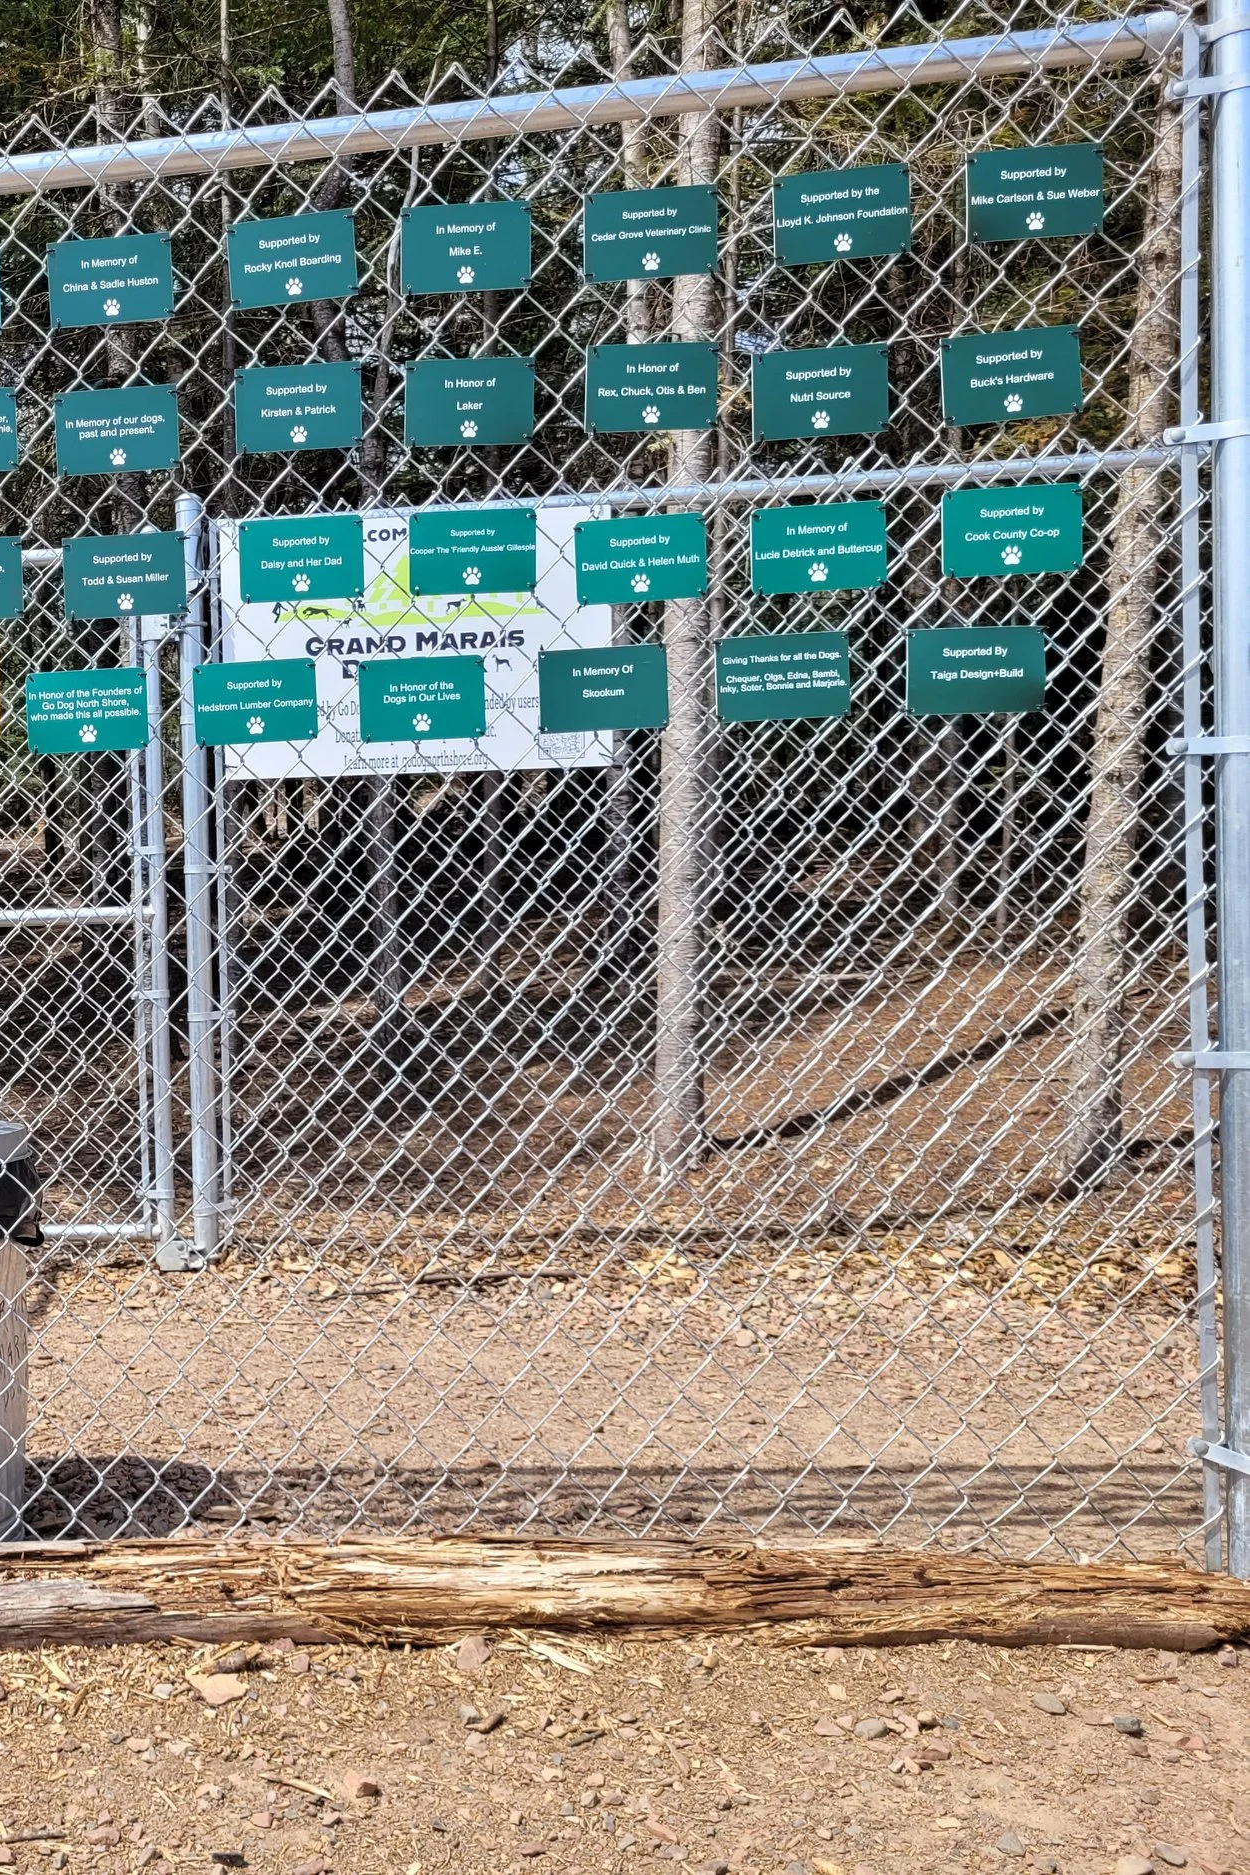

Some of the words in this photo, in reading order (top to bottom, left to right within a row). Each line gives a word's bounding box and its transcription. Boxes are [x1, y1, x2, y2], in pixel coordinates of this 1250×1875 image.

[970, 195, 994, 205] Mike
[996, 193, 1034, 203] Carlson
[1036, 190, 1044, 200] &
[1046, 190, 1065, 200] Sue
[1067, 188, 1101, 199] Weber
[776, 216, 802, 229] Lloyd
[803, 215, 813, 225] K.
[815, 212, 855, 223] Johnson
[856, 206, 908, 219] Foundation
[590, 232, 617, 242] Cedar
[618, 230, 644, 240] Grove
[644, 227, 687, 237] Veterinary
[688, 224, 711, 234] Clinic
[449, 246, 471, 256] Mike
[473, 245, 482, 255] E.
[244, 262, 272, 273] Rocky
[274, 258, 297, 269] Knoll
[299, 254, 341, 266] Boarding
[62, 282, 88, 293] China
[90, 280, 98, 290] &
[99, 279, 125, 289] Sadie
[126, 276, 158, 287] Huston
[970, 376, 1003, 388] Buck's
[1005, 371, 1054, 384] Hardware
[790, 391, 814, 403] Nutri
[815, 390, 851, 400] Source
[260, 407, 293, 418] Kirsten
[294, 406, 302, 415] &
[304, 404, 336, 415] Patrick
[456, 400, 483, 410] Laker
[964, 531, 990, 541] Cook
[992, 529, 1027, 540] County
[1029, 528, 1060, 538] Co-op
[754, 550, 780, 560] Lucie
[817, 545, 835, 556] and
[837, 544, 882, 554] Buttercup
[260, 560, 285, 570] Daisy
[286, 558, 304, 568] and
[305, 557, 322, 566] Her
[323, 555, 342, 565] Dad
[581, 560, 608, 571] David
[609, 559, 636, 569] Quick
[637, 557, 646, 567] &
[647, 556, 675, 566] Helen
[676, 554, 699, 564] Muth
[81, 576, 105, 586] Todd
[106, 575, 114, 584] &
[115, 574, 143, 584] Susan
[145, 572, 169, 582] Miller
[305, 636, 406, 657] GRAND
[416, 629, 525, 652] MARAIS
[942, 646, 992, 658] Supported
[994, 646, 1008, 657] By
[930, 670, 958, 681] Taiga
[959, 668, 1023, 680] Design+Build
[582, 687, 624, 698] Skookum
[197, 703, 238, 712] Hedstrom
[239, 700, 272, 710] Lumber
[273, 697, 314, 708] Company
[517, 696, 539, 709] users
[369, 758, 390, 769] more
[391, 756, 399, 768] at
